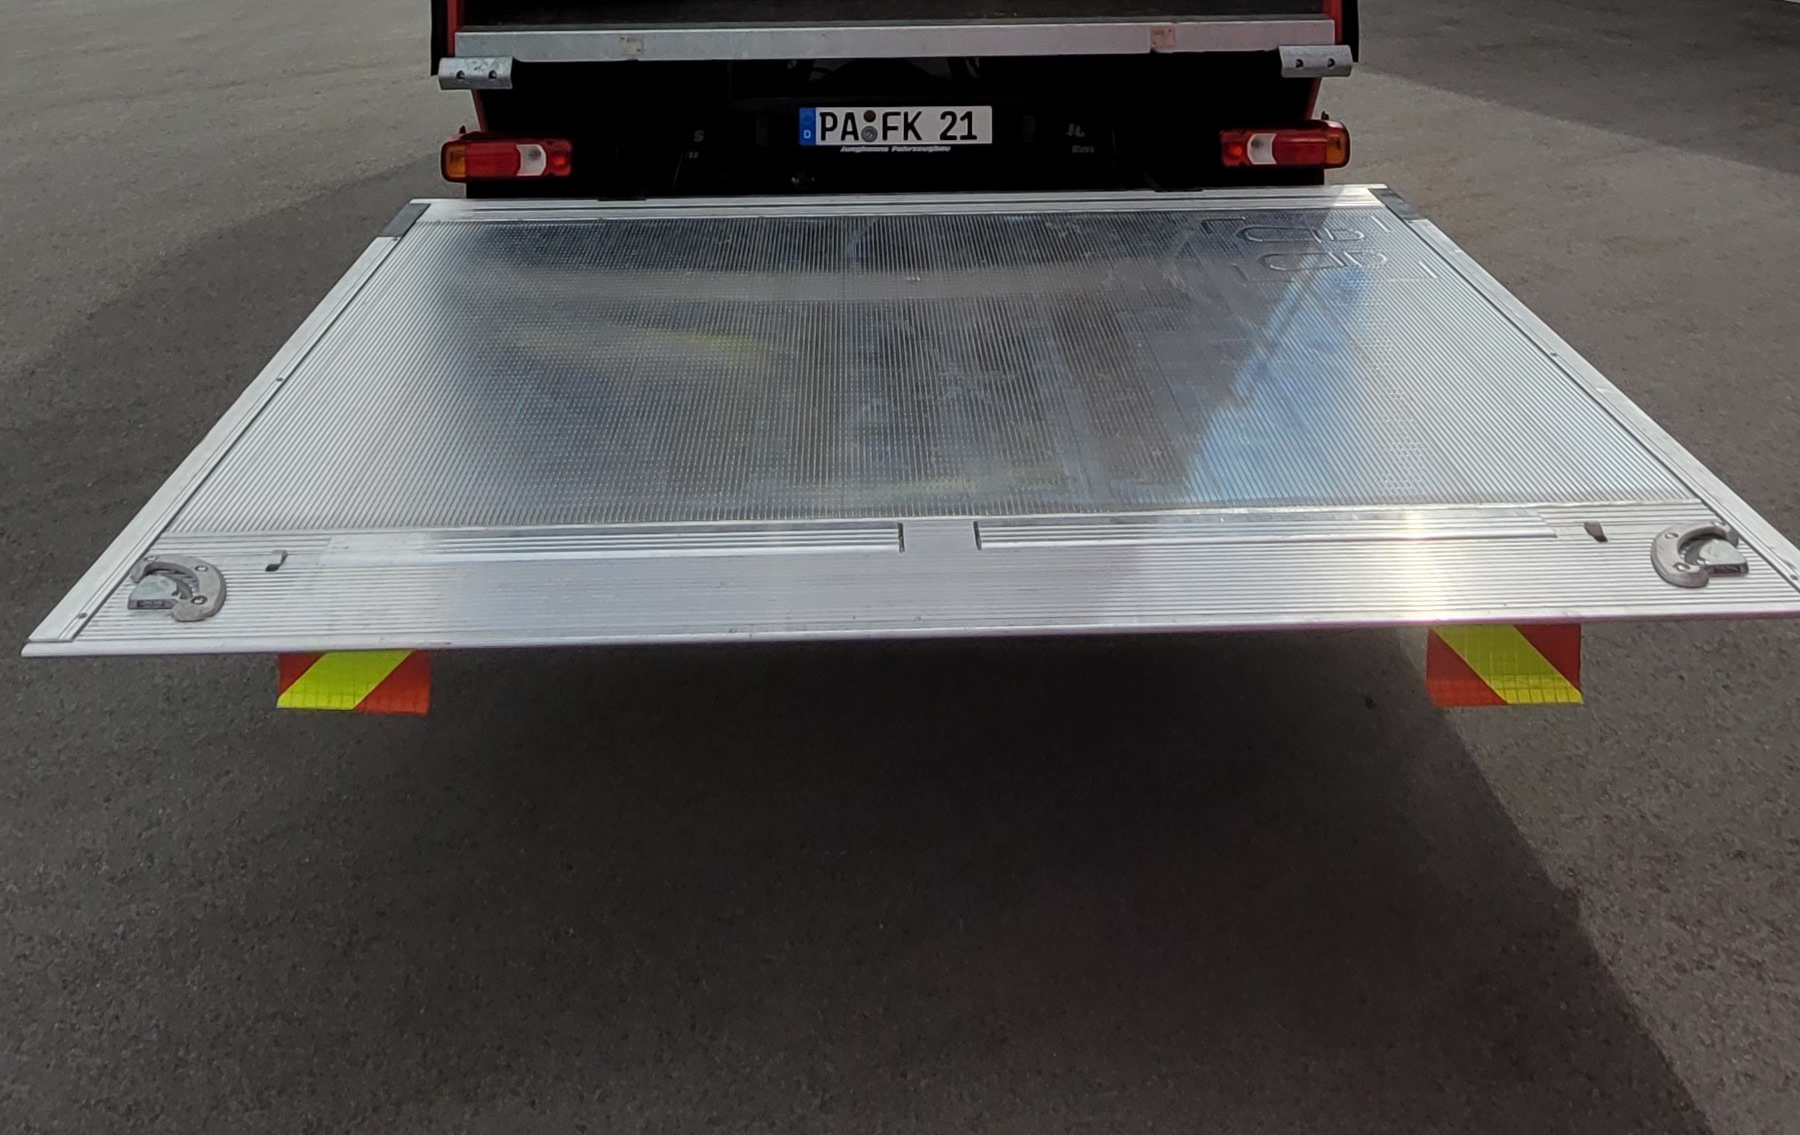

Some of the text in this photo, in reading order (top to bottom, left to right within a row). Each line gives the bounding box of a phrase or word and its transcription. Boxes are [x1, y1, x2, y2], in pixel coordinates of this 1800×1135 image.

[803, 129, 812, 139] D
[820, 111, 978, 141] PA FK 21
